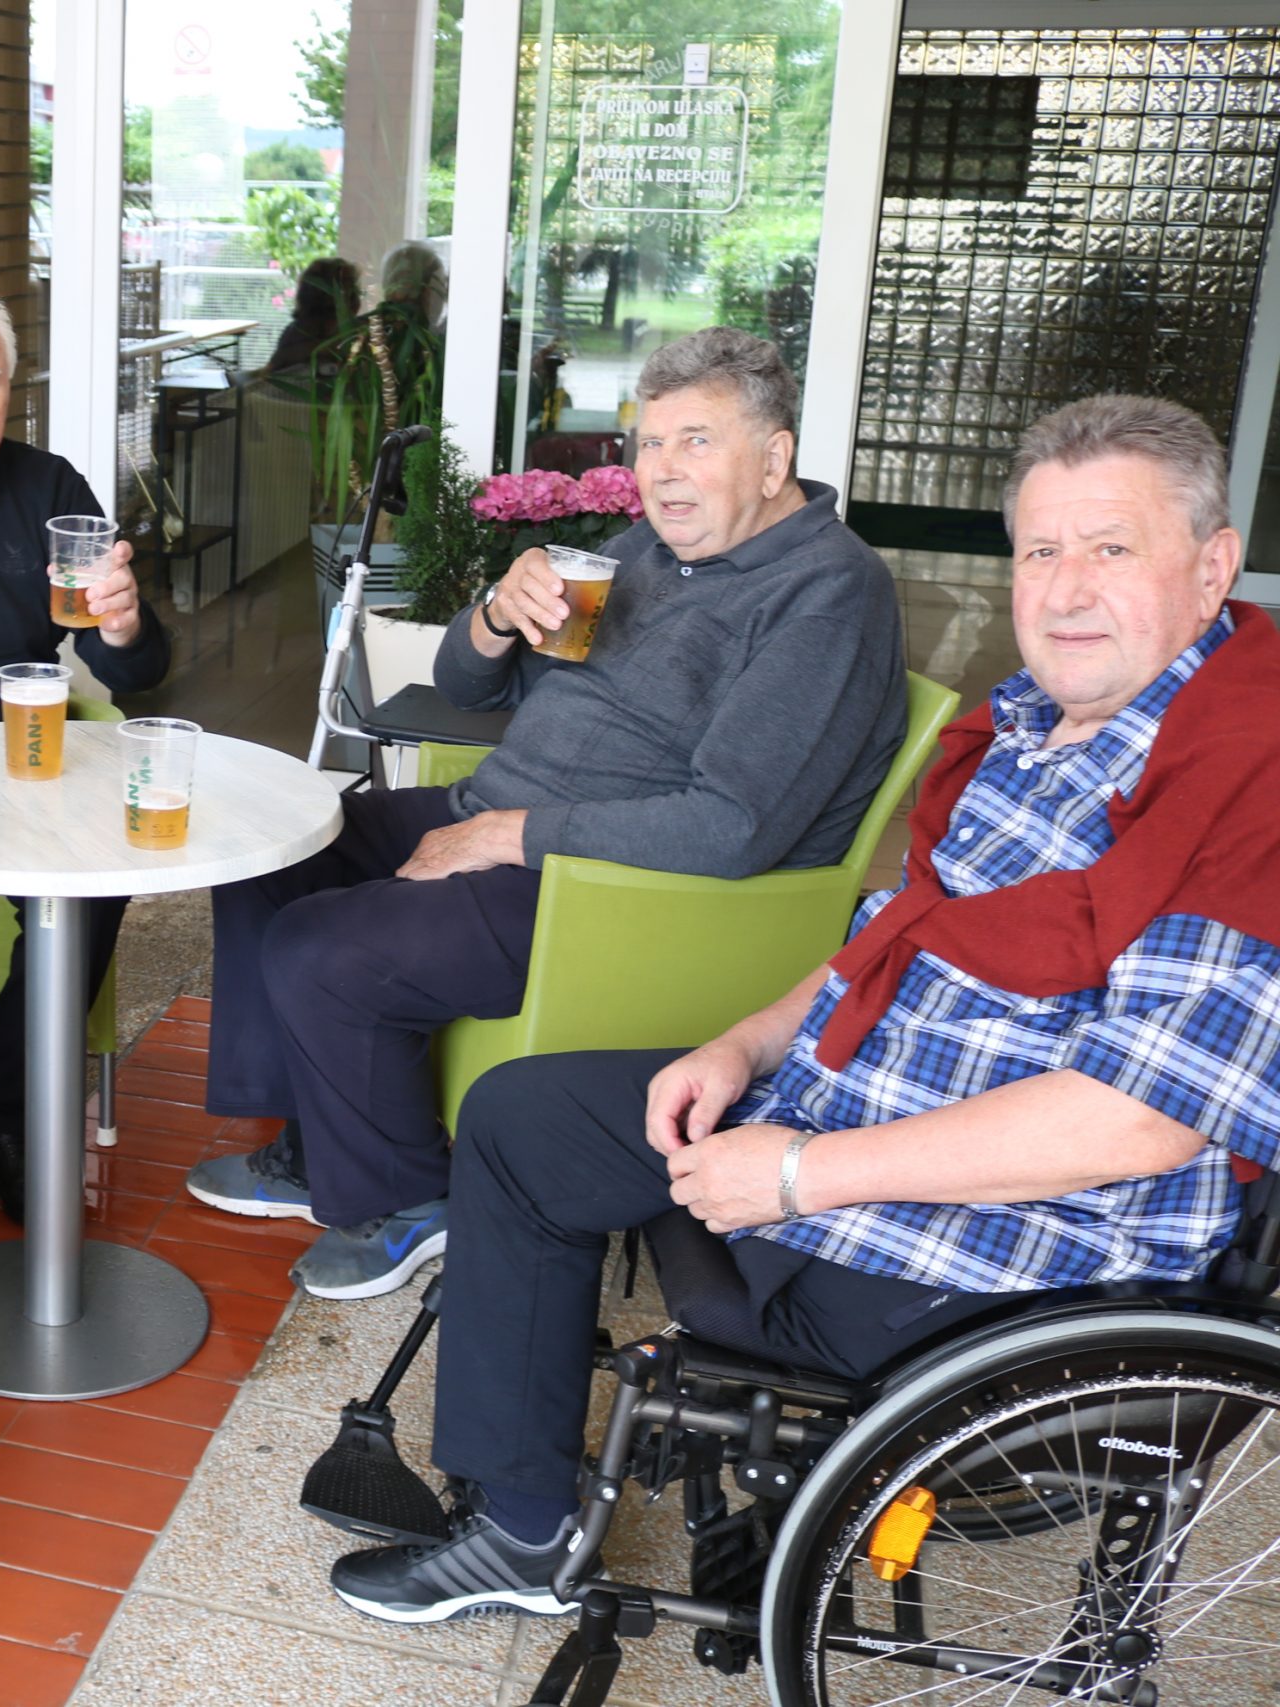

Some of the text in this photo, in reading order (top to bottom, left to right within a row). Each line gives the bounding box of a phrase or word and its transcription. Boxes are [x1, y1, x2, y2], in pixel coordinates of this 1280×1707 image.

[596, 100, 736, 116] PRILIKOM ULASKA
[654, 123, 688, 138] DOM
[592, 145, 734, 161] OBAVEZNO SE
[634, 168, 653, 182] NA
[656, 168, 731, 183] RECEPCIJU
[28, 724, 42, 767] PAN
[128, 783, 140, 832] PAN
